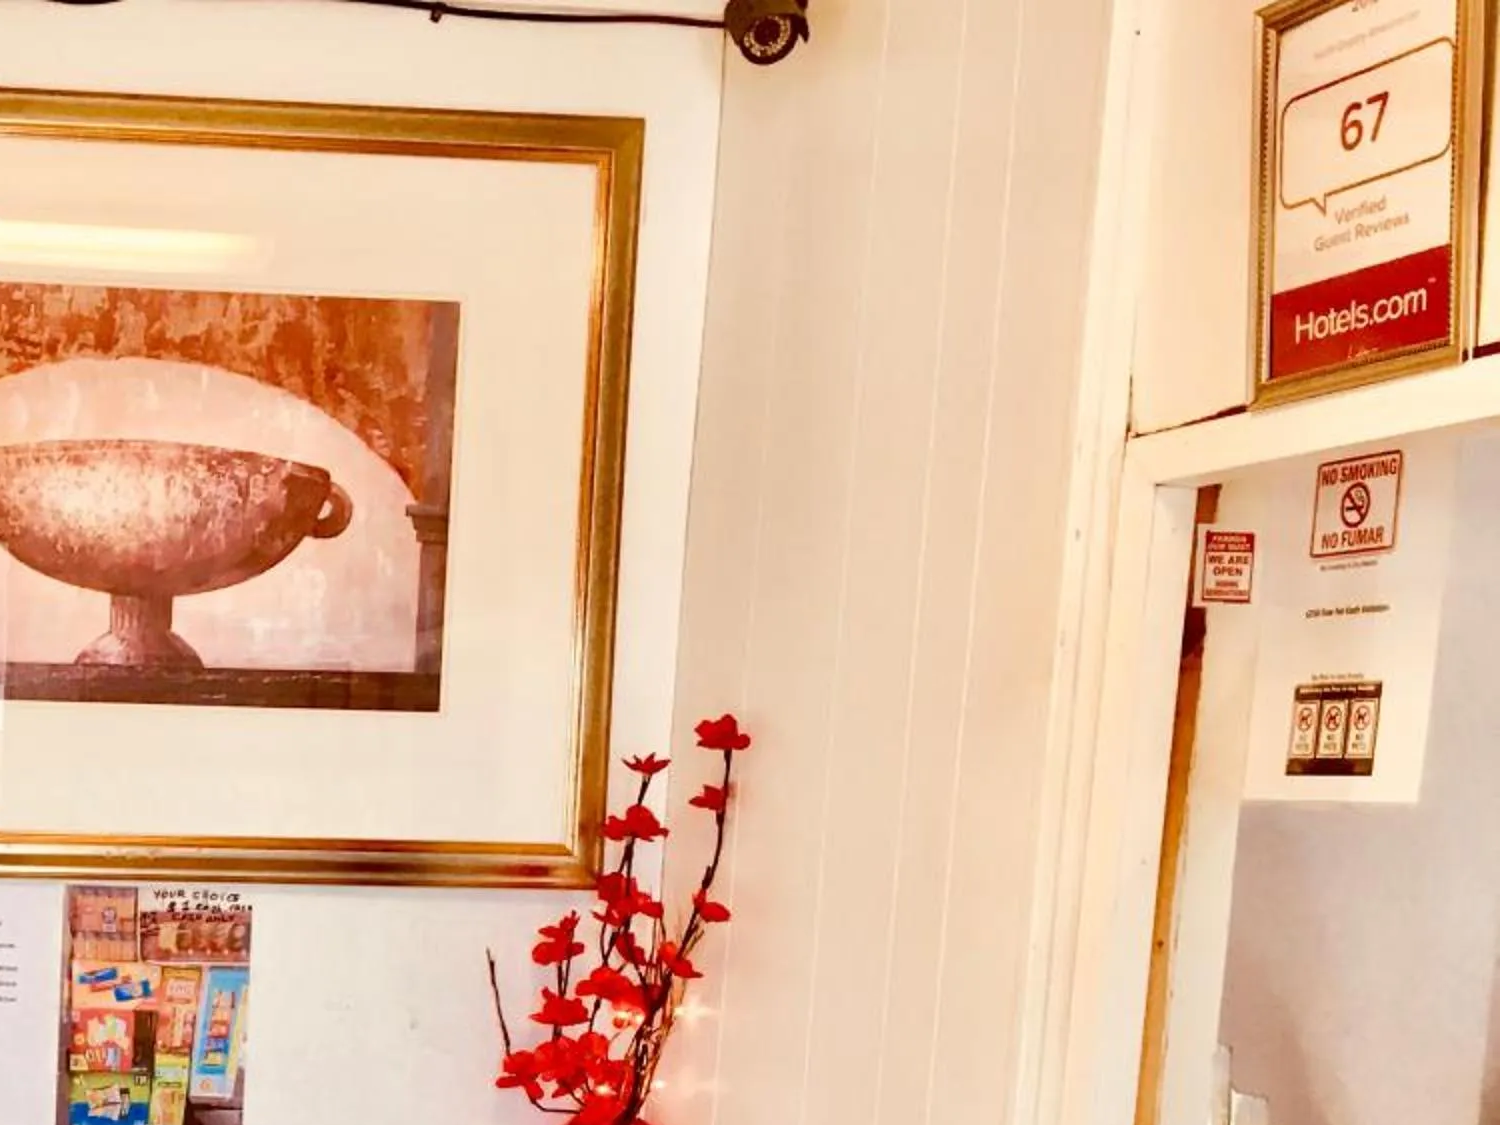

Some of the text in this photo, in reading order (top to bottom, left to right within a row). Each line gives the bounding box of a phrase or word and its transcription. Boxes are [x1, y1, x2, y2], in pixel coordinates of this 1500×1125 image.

[1339, 91, 1390, 152] 67
[1334, 193, 1388, 226] Verified
[1313, 210, 1410, 254] Guest Reviews
[1294, 287, 1428, 345] Hotels.com
[1321, 458, 1398, 486] NO SMOKING
[1321, 526, 1385, 549] NO FUMAR
[1208, 555, 1249, 564] WE ARE
[1213, 566, 1243, 577] OPEN
[154, 889, 187, 899] YOUR
